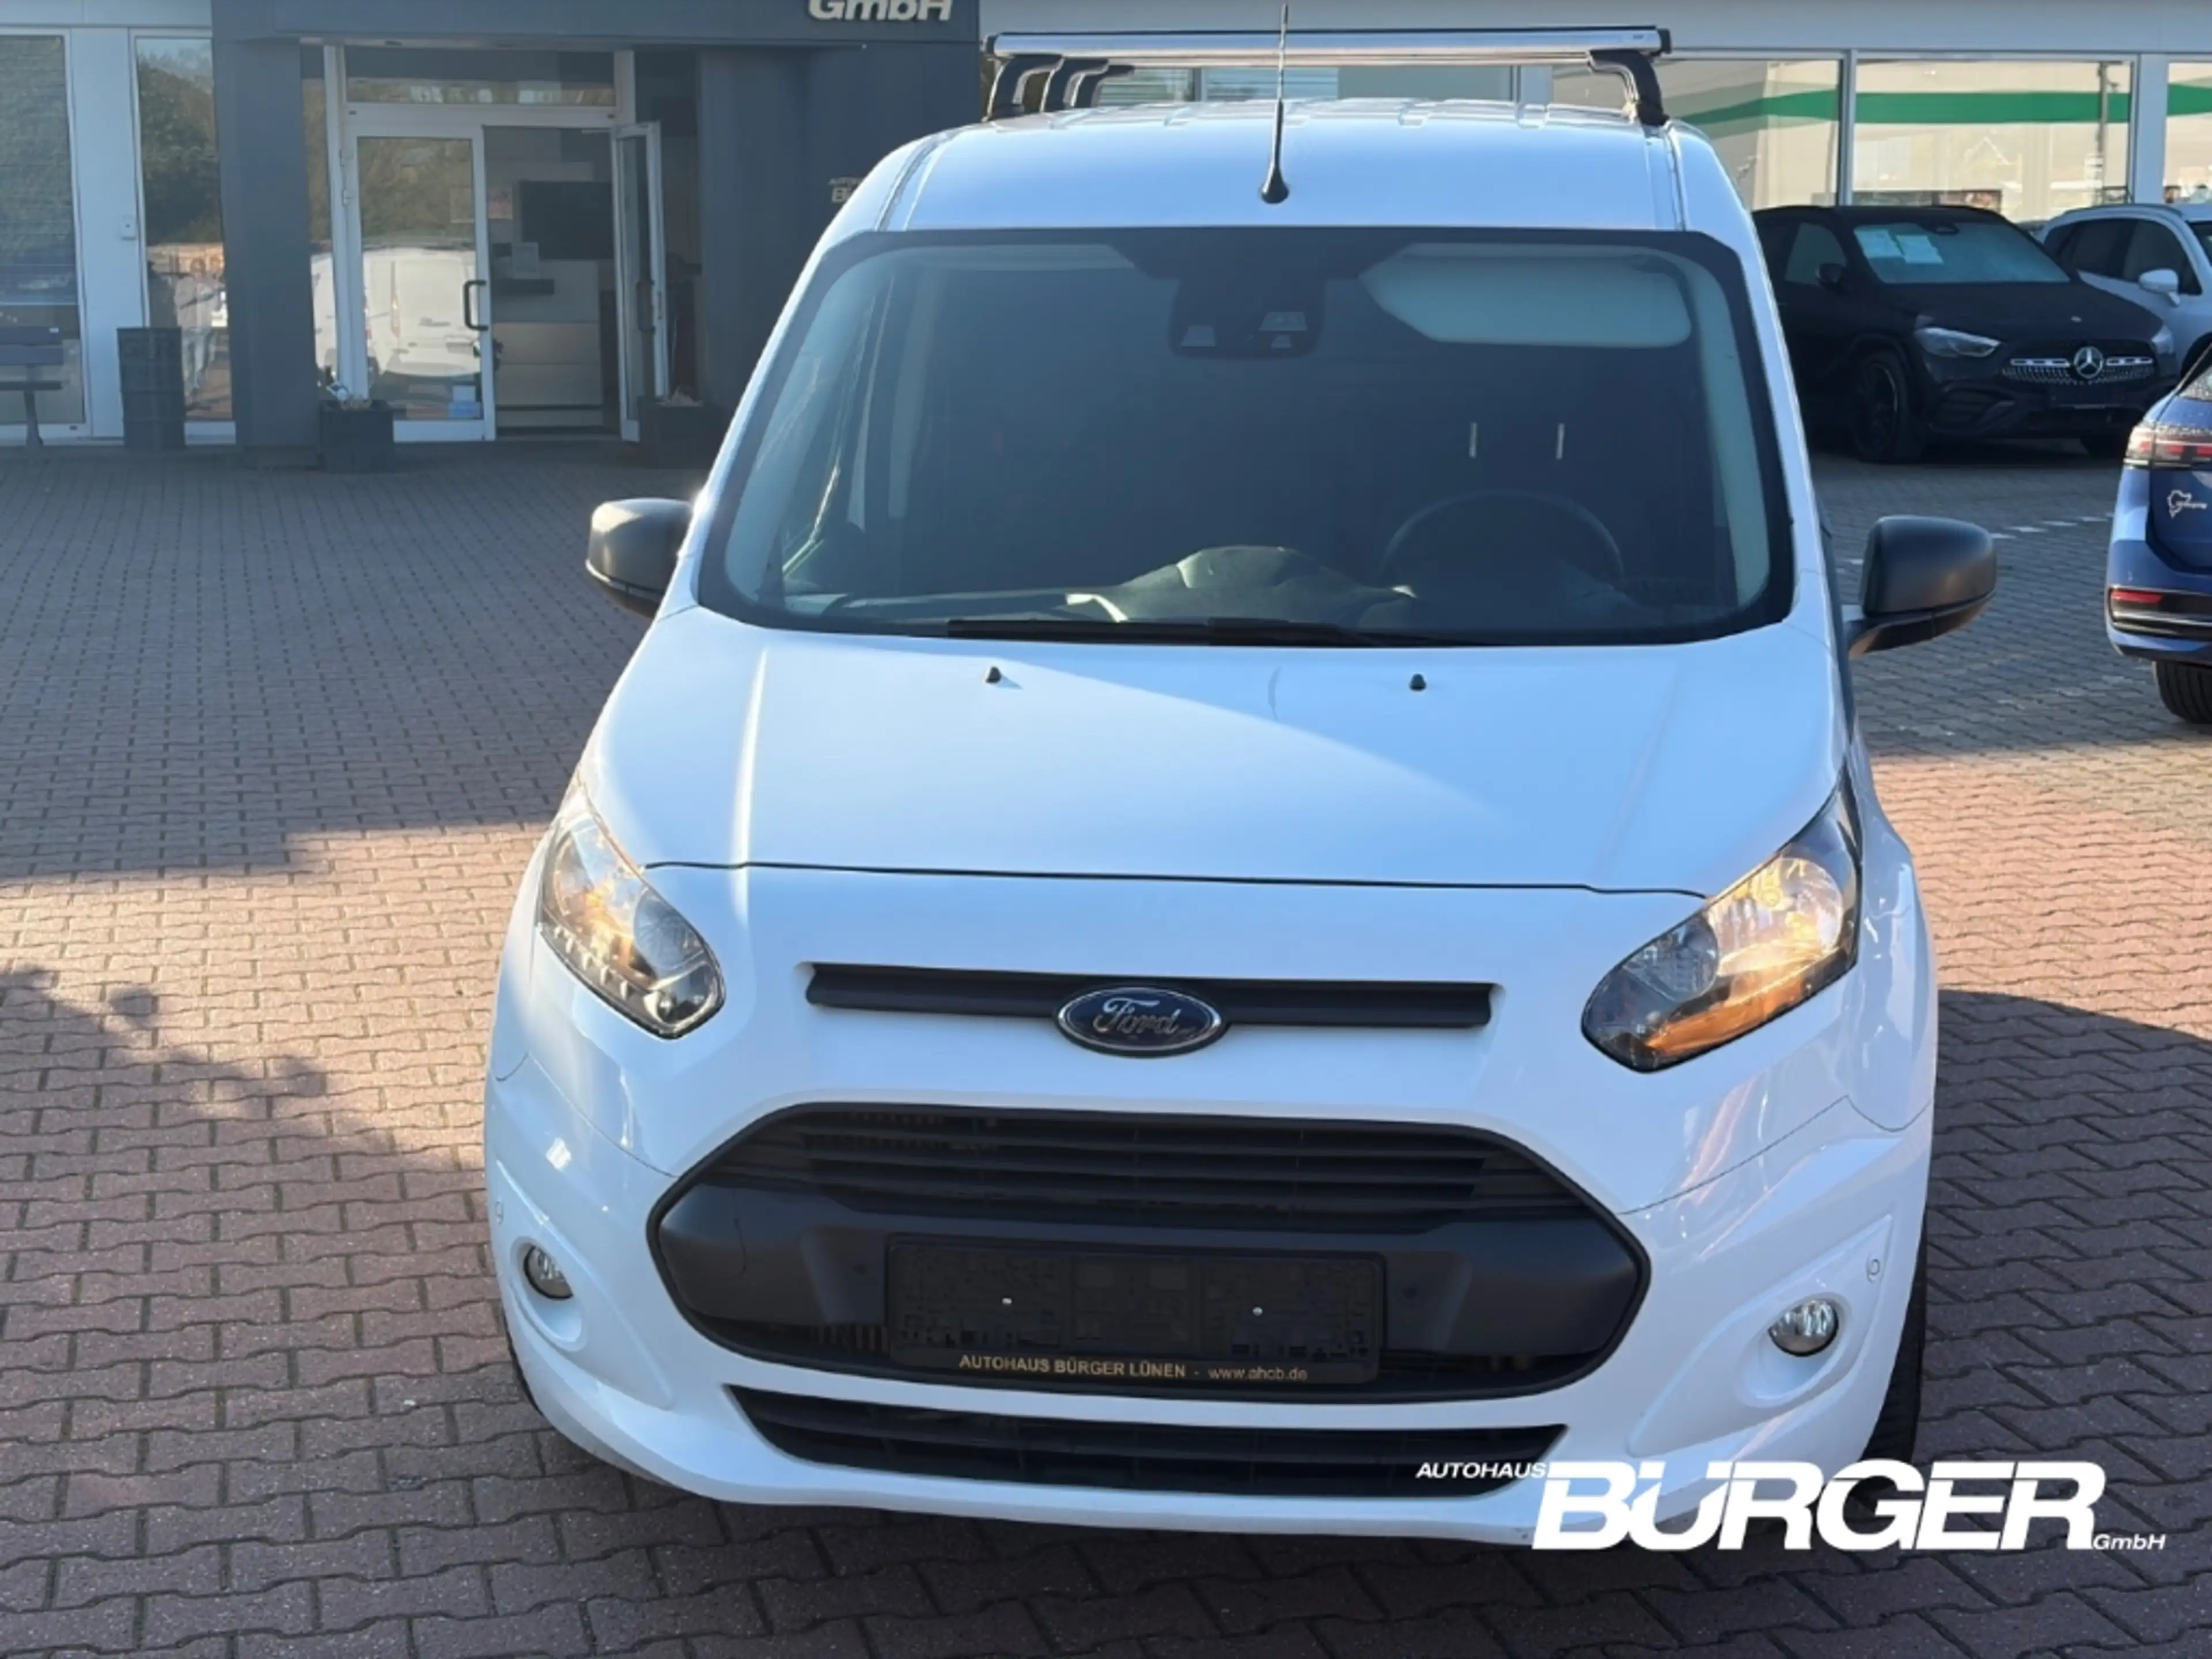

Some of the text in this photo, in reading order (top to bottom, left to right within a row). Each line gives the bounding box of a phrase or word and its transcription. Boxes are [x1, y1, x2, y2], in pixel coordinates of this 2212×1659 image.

[809, 0, 952, 21] GmbH
[1093, 997, 1182, 1035] Ford
[959, 1354, 1051, 1373] AUTOHAUS
[1054, 1357, 1124, 1376] BÜRGER
[1129, 1359, 1186, 1378] LÜNEN
